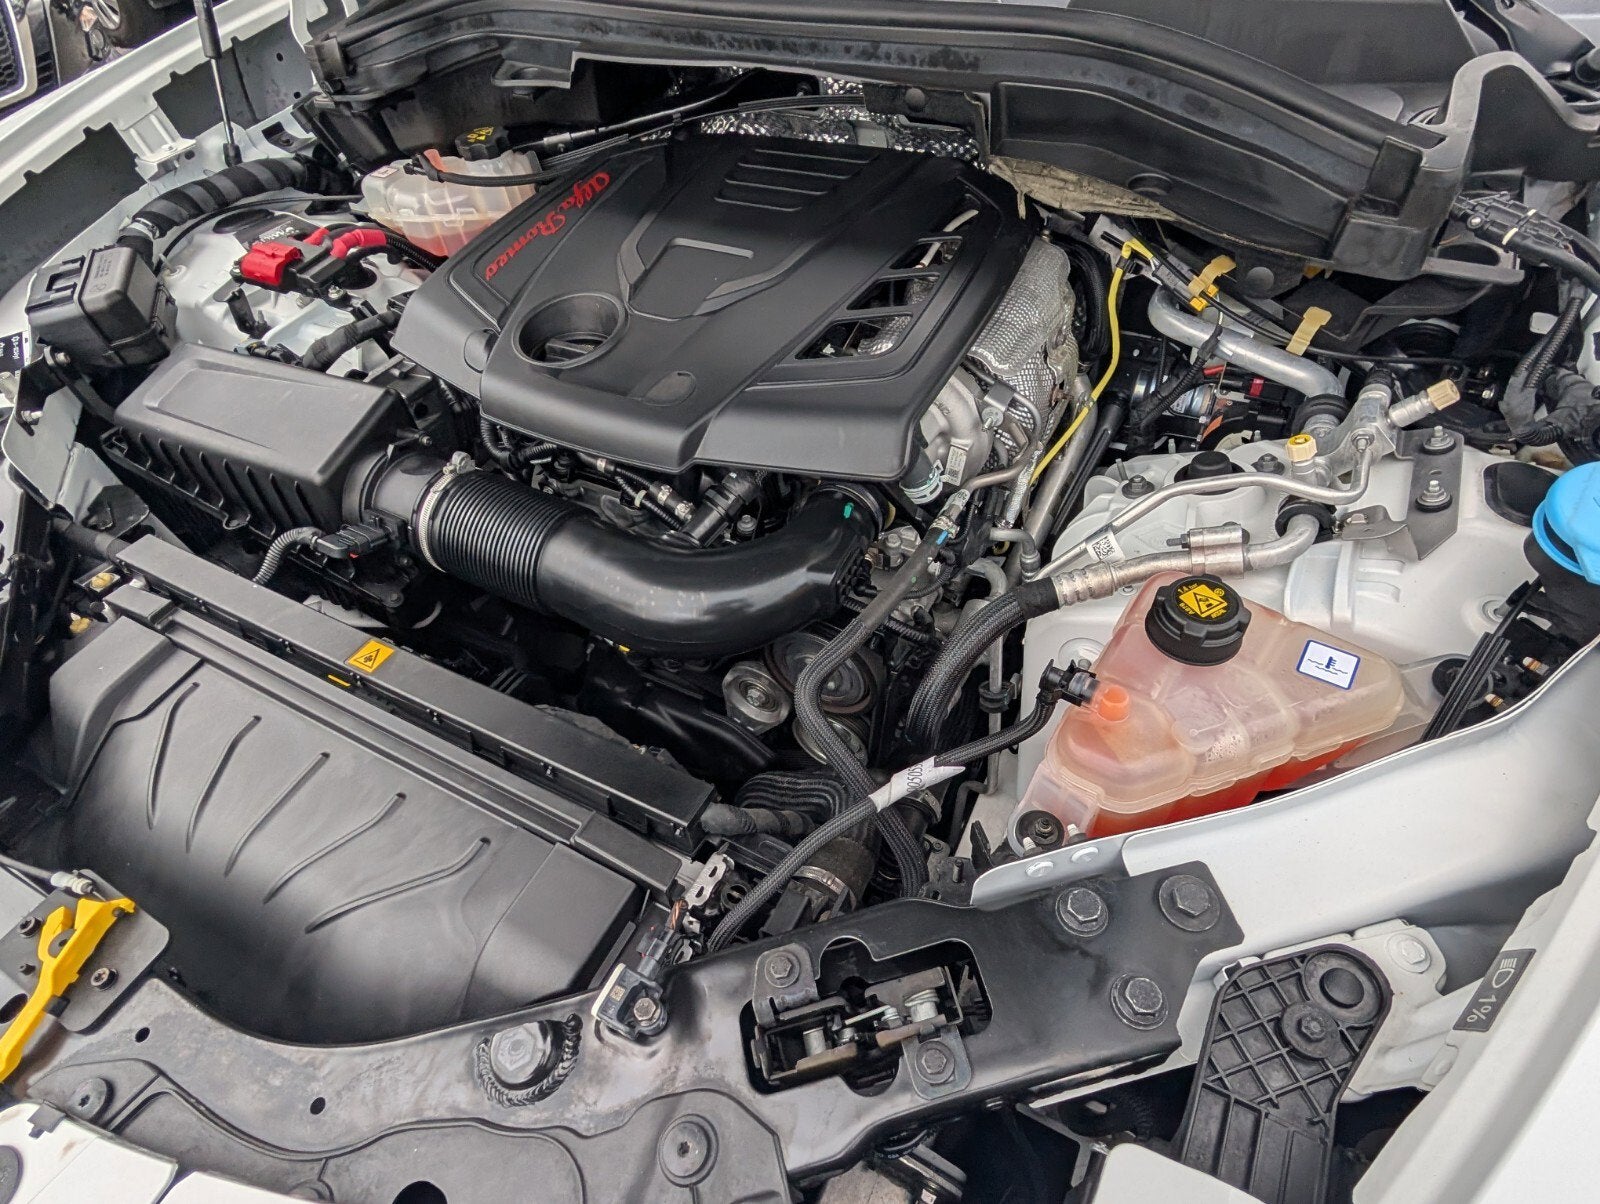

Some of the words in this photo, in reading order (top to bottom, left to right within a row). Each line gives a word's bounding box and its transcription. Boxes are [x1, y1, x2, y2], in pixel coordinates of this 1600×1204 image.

[557, 172, 610, 212] Alfa
[485, 211, 566, 282] Romeo
[1466, 994, 1497, 1023] 1%
